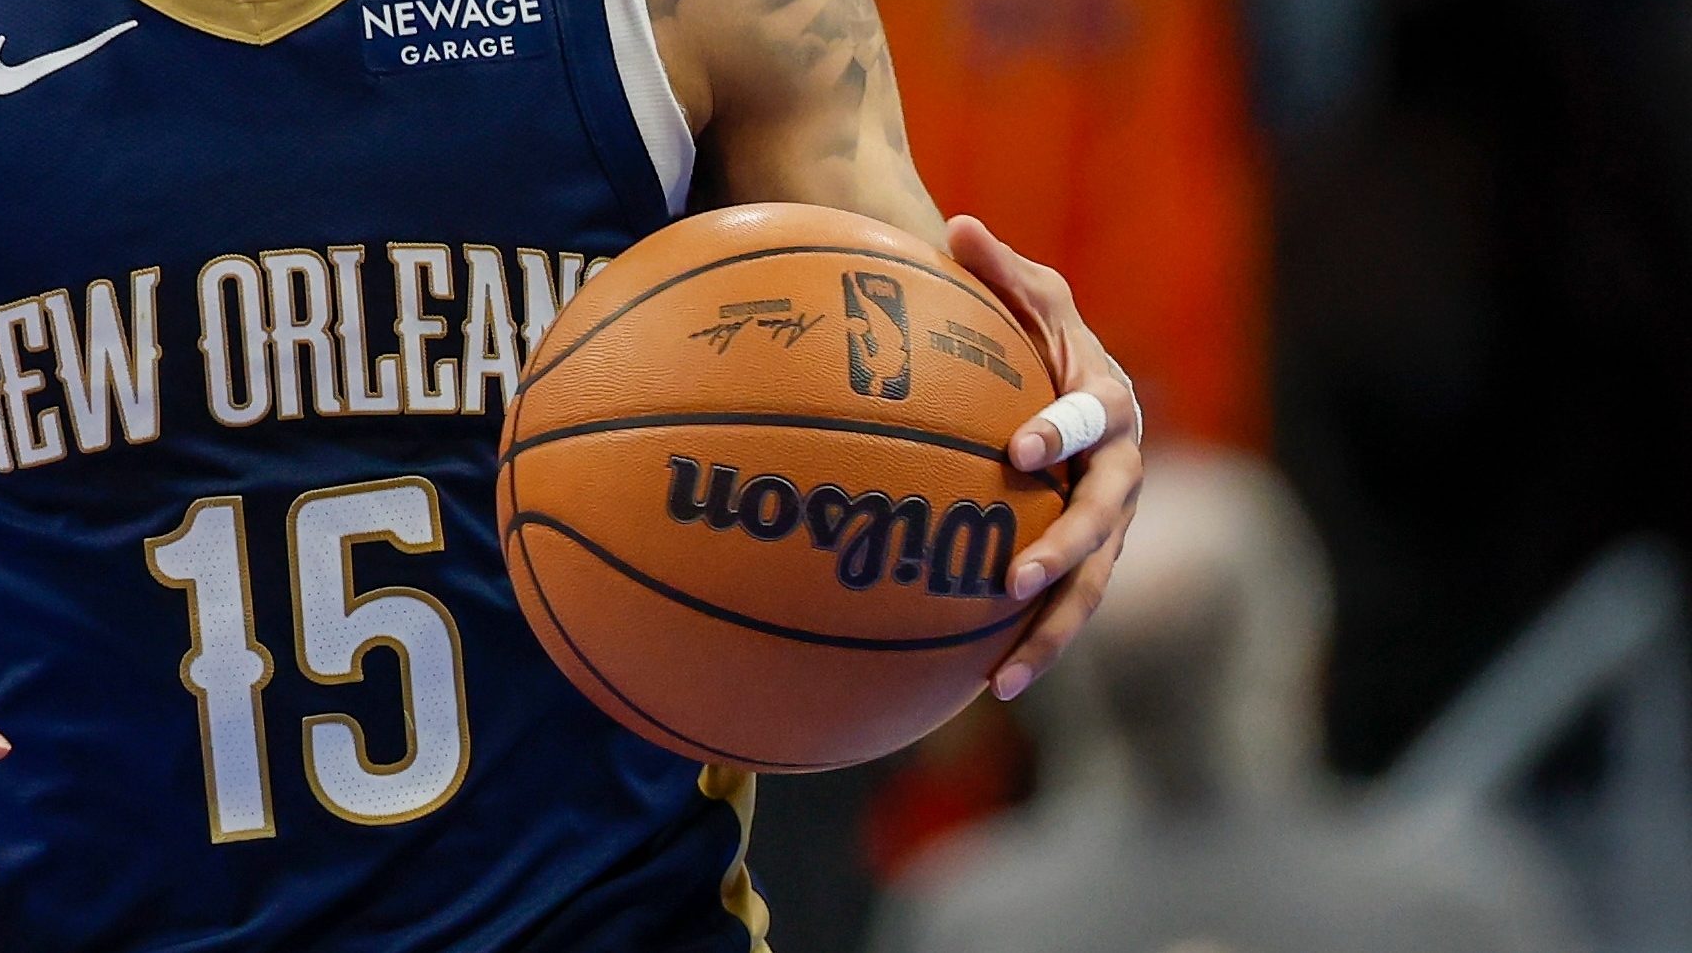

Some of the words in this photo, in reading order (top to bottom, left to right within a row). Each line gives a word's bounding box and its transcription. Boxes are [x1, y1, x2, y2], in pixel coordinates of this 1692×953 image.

[401, 35, 515, 65] GARAGE
[199, 242, 613, 427] ORLEAN
[665, 454, 1018, 599] Wilson
[144, 475, 471, 844] 15
